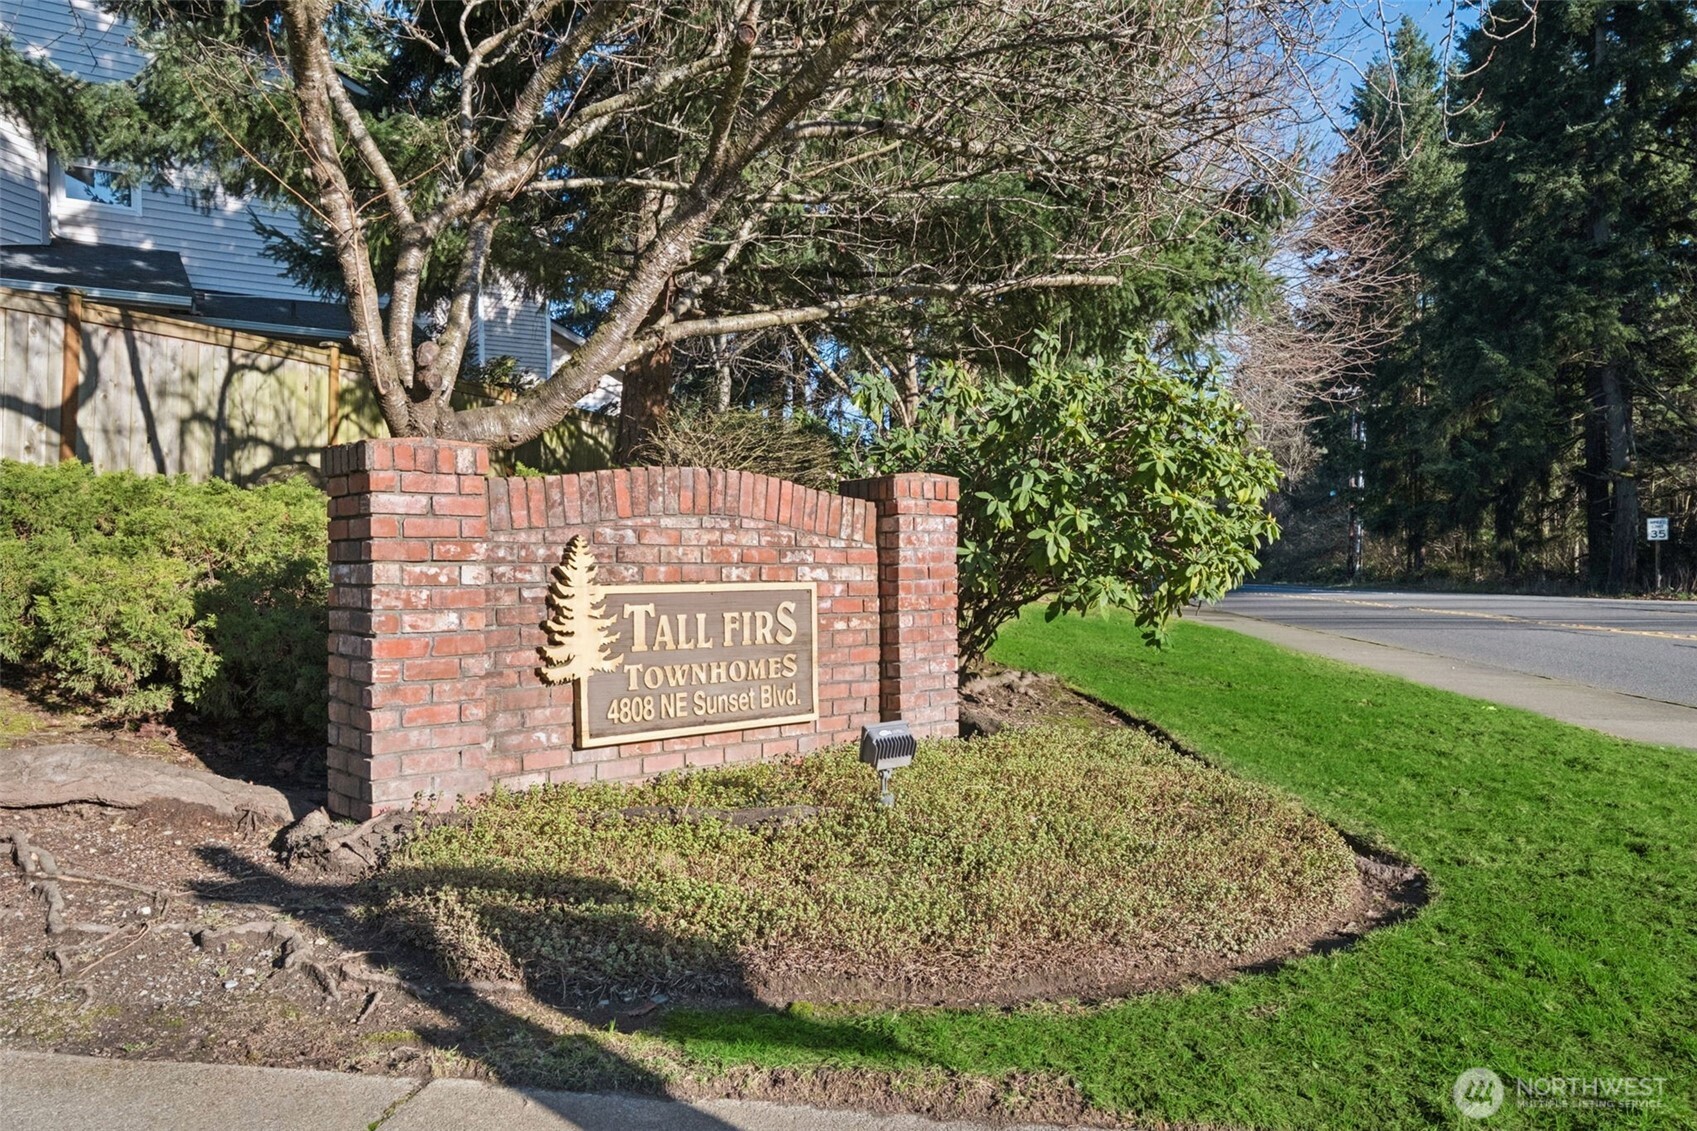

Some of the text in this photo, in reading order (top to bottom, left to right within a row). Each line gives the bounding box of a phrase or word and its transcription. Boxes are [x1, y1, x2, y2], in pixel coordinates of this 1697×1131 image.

[1651, 530, 1666, 539] 35
[623, 600, 798, 652] TALL FIRS
[623, 653, 798, 690] TOWNHOMES
[607, 682, 801, 724] 4808 NE Sunset Blvd.
